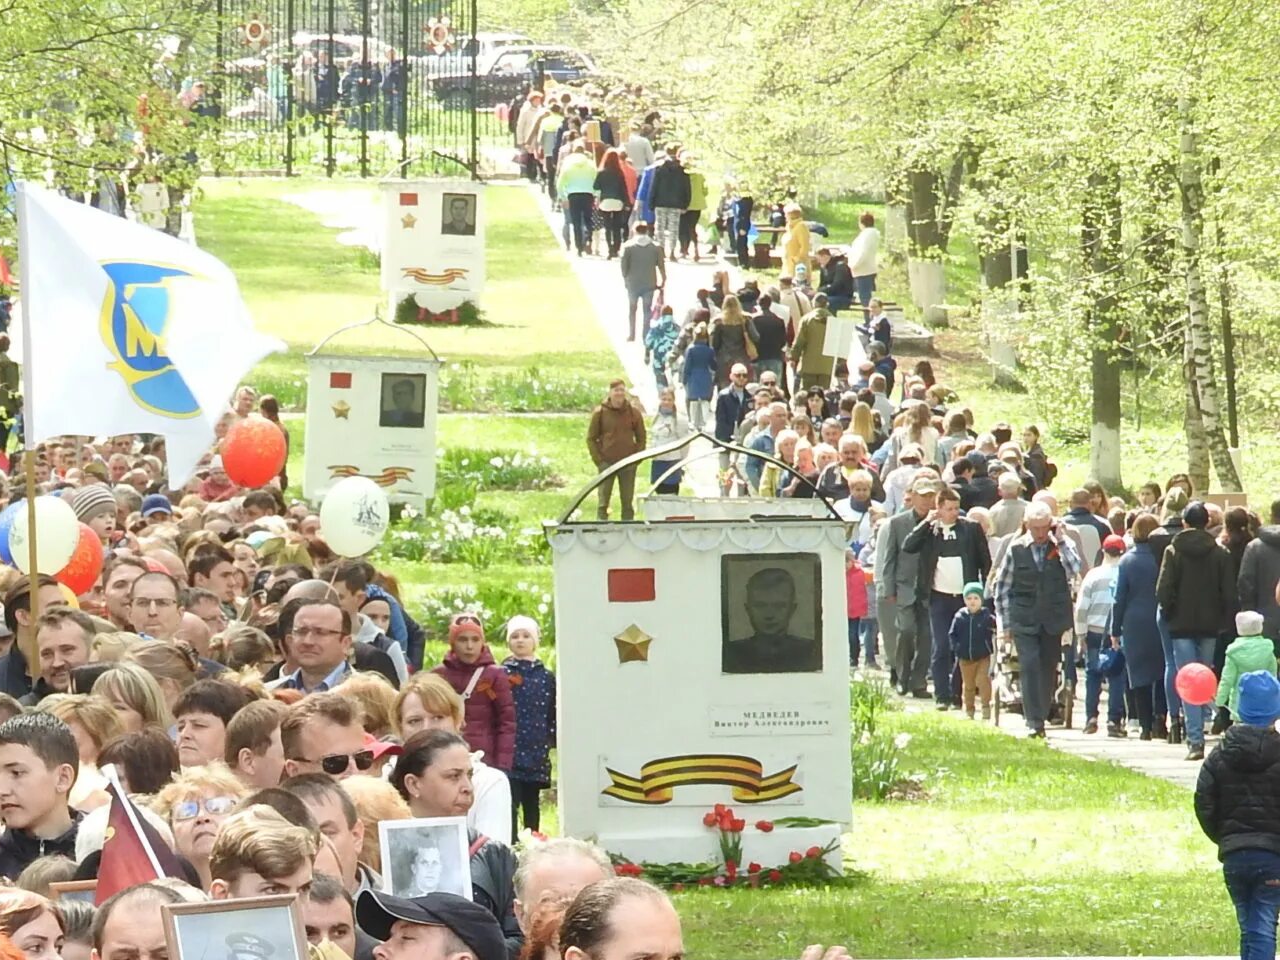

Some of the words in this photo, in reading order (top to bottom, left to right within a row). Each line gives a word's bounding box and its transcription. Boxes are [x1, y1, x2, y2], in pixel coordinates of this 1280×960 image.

[743, 711, 800, 719] МЕДВЕДЕВ
[714, 720, 749, 728] Виктор
[754, 720, 829, 728] Александрович
